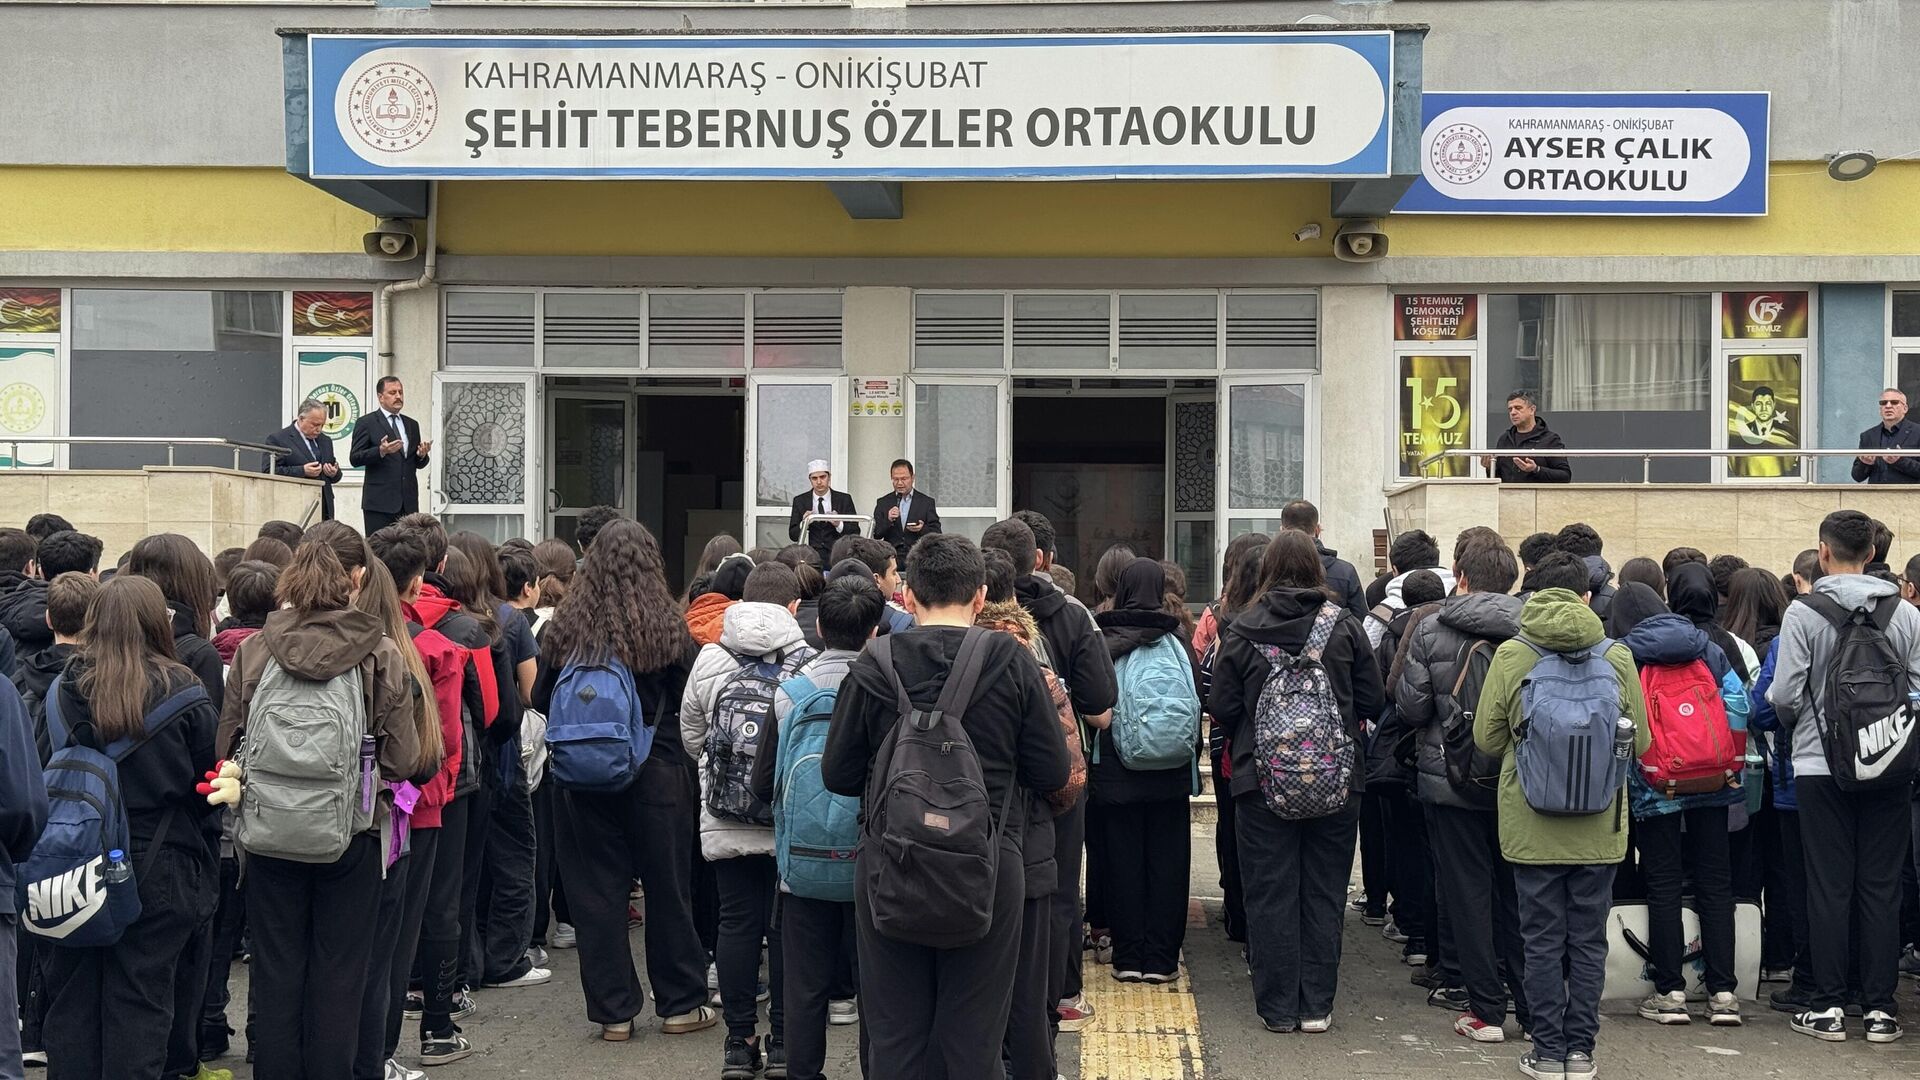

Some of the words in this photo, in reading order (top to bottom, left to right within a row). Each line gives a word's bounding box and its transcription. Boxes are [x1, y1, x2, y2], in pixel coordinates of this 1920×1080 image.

[465, 62, 766, 95] KAHRAMANMARAŞ
[795, 57, 987, 95] ONİKİŞUBAT
[465, 100, 598, 159] ŞEHİT
[606, 109, 851, 159] TEBERNUŞ
[864, 100, 1014, 148] ÖZLER
[1026, 106, 1316, 148] ORTAOKULU
[1508, 118, 1605, 132] KAHRAMANMARAŞ
[1612, 118, 1675, 132] ONİKİŞUBAT
[1504, 137, 1606, 158] AYSER
[1614, 137, 1713, 164] ÇALIK
[1503, 169, 1688, 191] ORTAOKULU
[1405, 305, 1465, 315] DEMOKRASİ
[1407, 297, 1418, 305] 15
[1421, 297, 1464, 305] TEMMUZ
[1410, 316, 1459, 327] ŞEHİTLERİ
[1412, 326, 1457, 337] KÖŞEMİZ
[1406, 377, 1461, 429] 15
[1858, 704, 1907, 759] NIKE
[28, 855, 103, 920] NIKE
